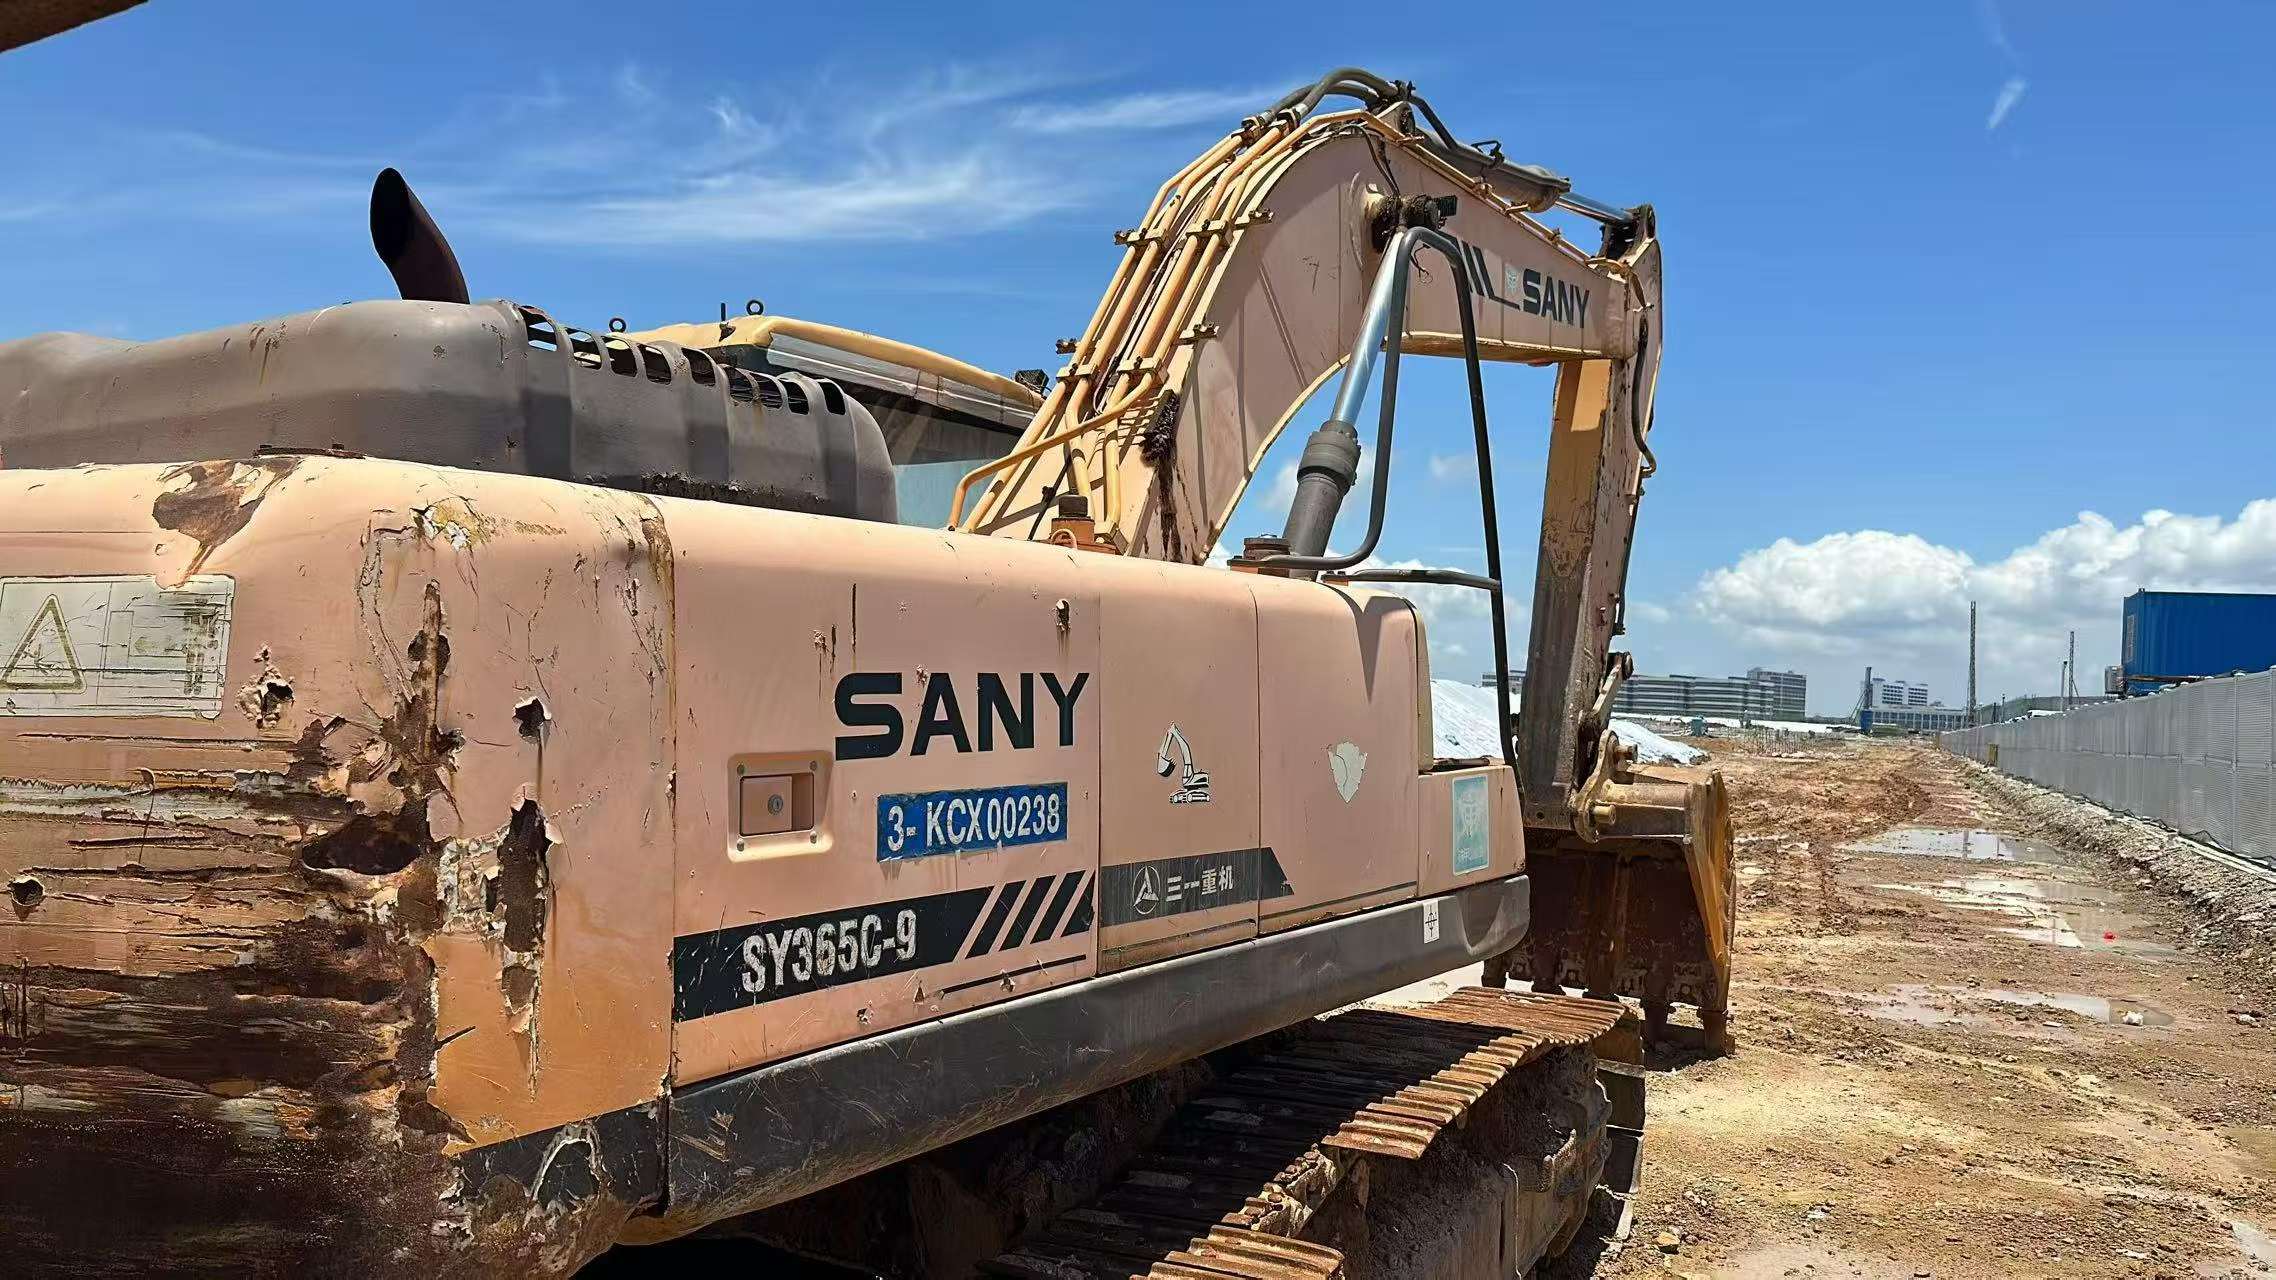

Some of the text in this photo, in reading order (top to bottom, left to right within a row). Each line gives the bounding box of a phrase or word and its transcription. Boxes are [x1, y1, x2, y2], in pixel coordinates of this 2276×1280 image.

[1523, 268, 1590, 329] SANY
[834, 672, 1090, 761] SANY
[1165, 865, 1234, 903] 三一重机
[741, 908, 917, 993] SY365C-9
